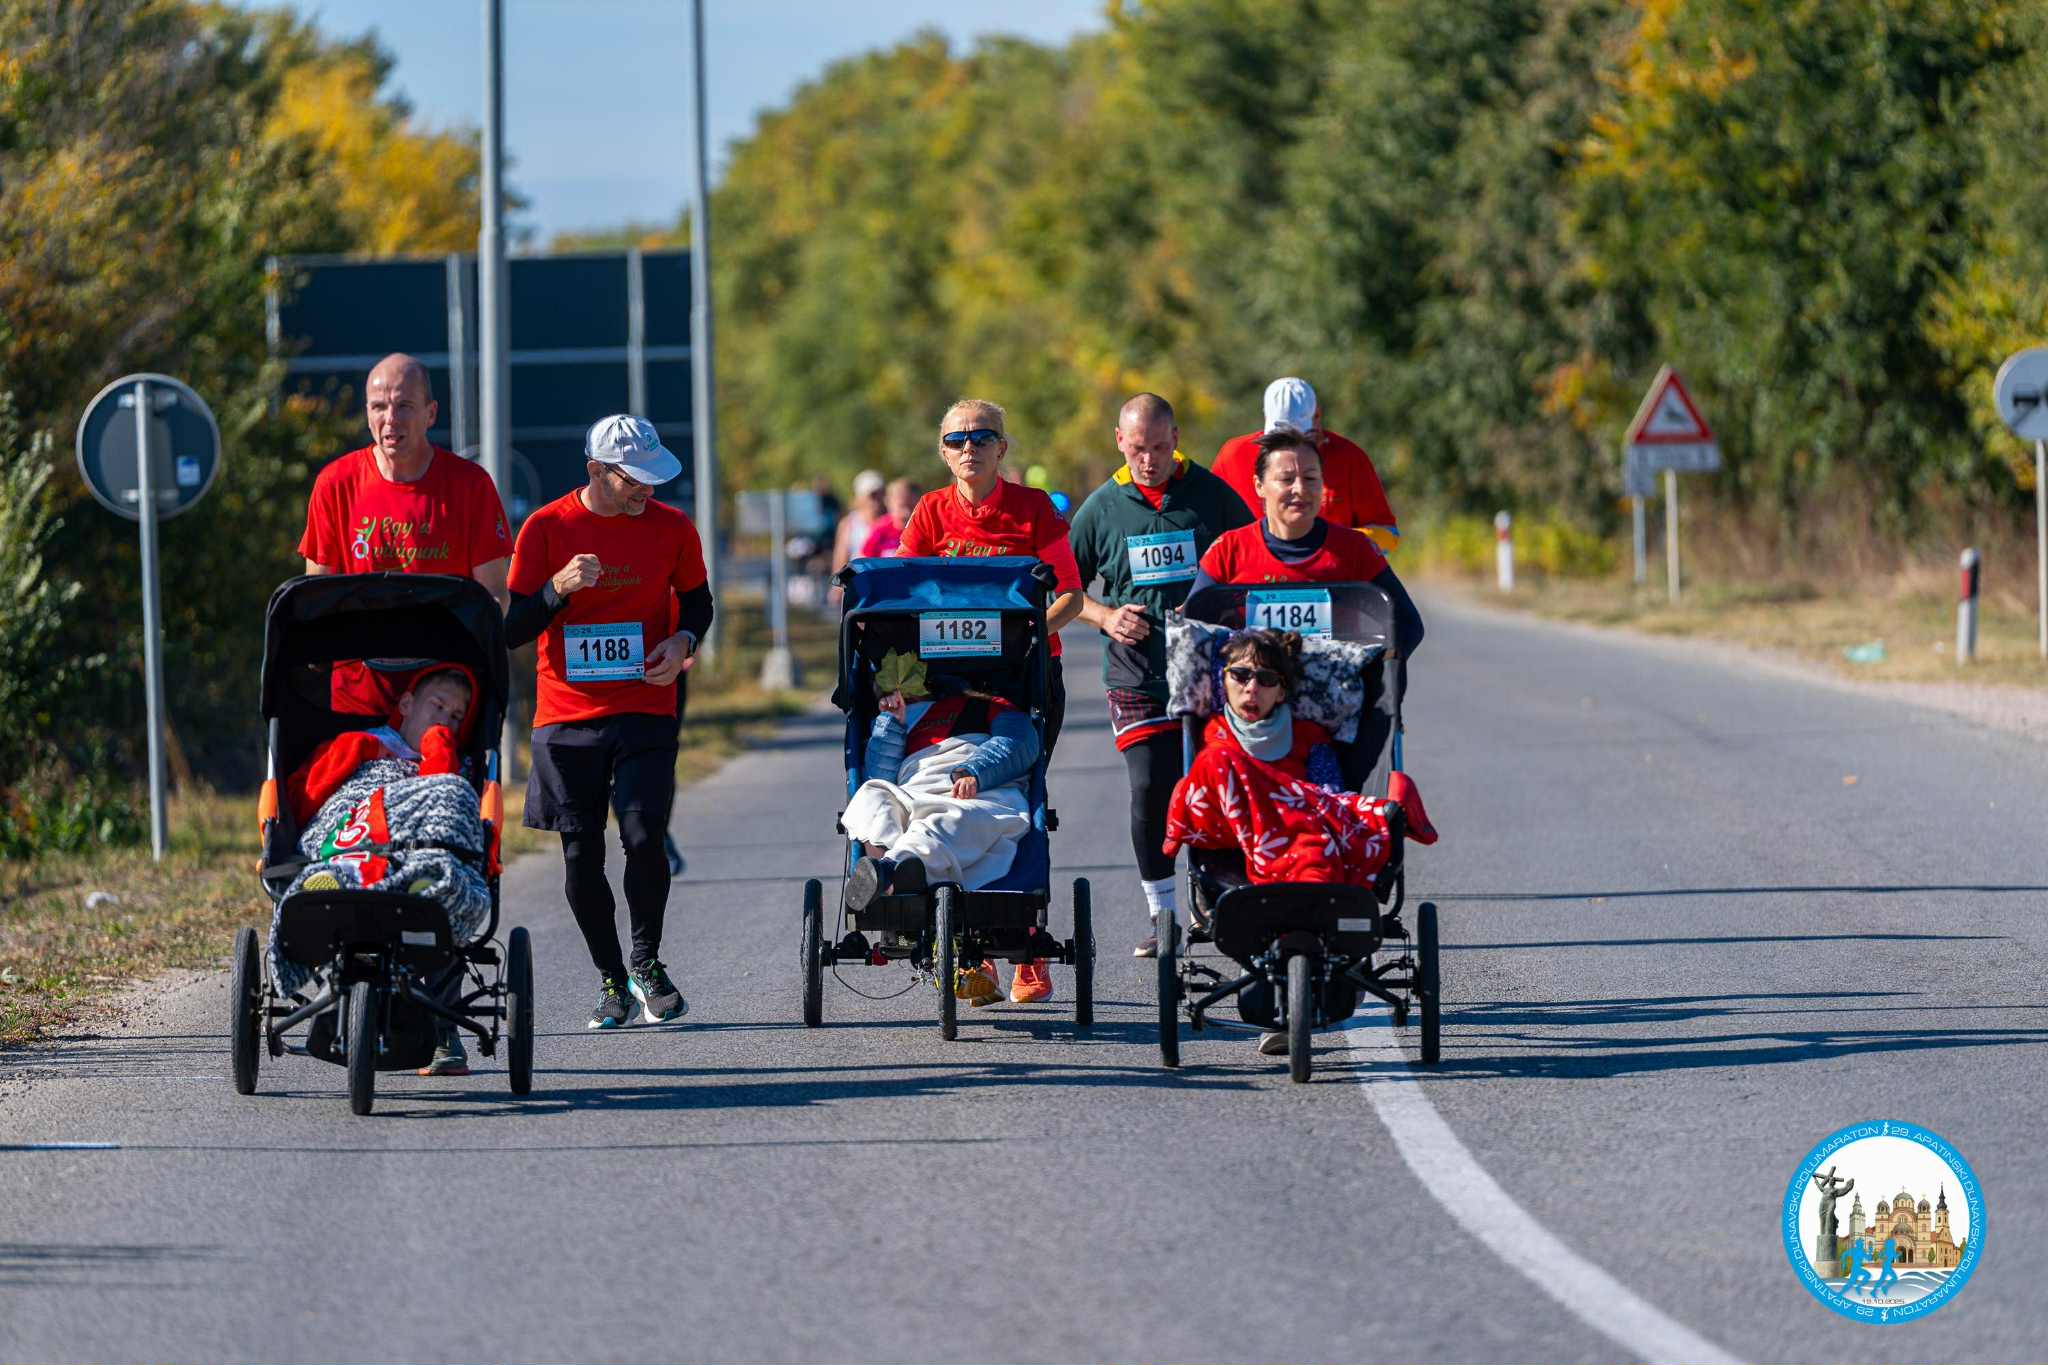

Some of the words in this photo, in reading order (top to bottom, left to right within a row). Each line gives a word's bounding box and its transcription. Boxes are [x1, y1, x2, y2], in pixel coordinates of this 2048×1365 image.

[381, 516, 413, 539] Egy
[1141, 544, 1184, 568] 1094
[1262, 604, 1317, 628] 1184
[935, 620, 988, 640] 1182
[579, 637, 631, 662] 1188
